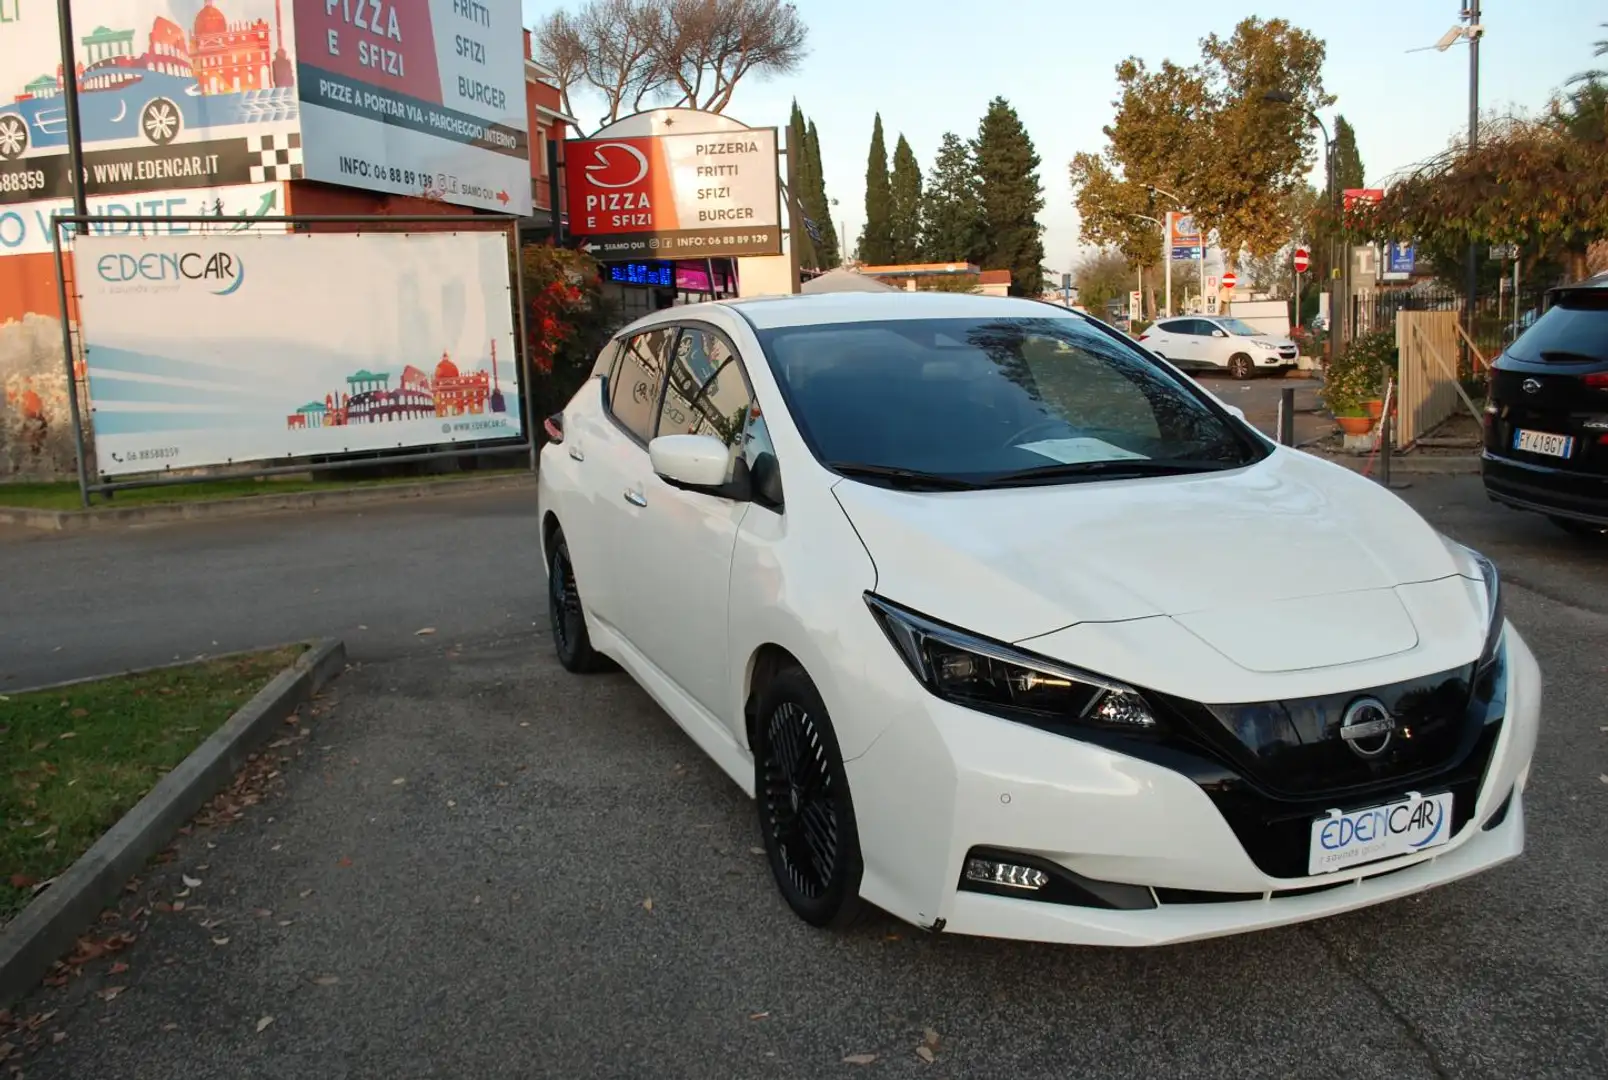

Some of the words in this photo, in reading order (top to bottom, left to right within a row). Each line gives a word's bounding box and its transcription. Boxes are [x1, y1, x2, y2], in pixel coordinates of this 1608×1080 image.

[328, 28, 339, 56] E
[359, 40, 404, 77] SFIZI
[455, 34, 486, 66] SFIZI
[458, 76, 506, 111] BURGER
[319, 79, 353, 104] PIZZE
[354, 89, 363, 107] A
[364, 92, 406, 119] PORTAR
[406, 104, 424, 124] VIA
[428, 111, 483, 140] PARCHEGGIO
[484, 128, 517, 149] INTERNO
[696, 141, 759, 156] PIZZERIA
[93, 154, 219, 184] WWW.EDENCAR.IT
[339, 156, 373, 178] INFO:
[374, 165, 387, 180] 06
[389, 167, 402, 183] 88
[404, 170, 416, 185] 89
[418, 173, 433, 188] 139
[696, 164, 739, 178] FRITTI
[0, 169, 45, 193] 88359
[461, 183, 482, 198] SIAMO
[586, 191, 651, 212] PIZZA
[697, 186, 731, 200] SFIZI
[587, 216, 597, 228] E
[612, 213, 653, 227] SFIZI
[698, 207, 754, 222] BURGER
[604, 242, 630, 251] SIAMO
[630, 241, 646, 250] QUI
[677, 236, 707, 247] INFO:
[708, 236, 721, 246] 06
[723, 235, 735, 245] 88
[737, 235, 749, 245] 89
[751, 233, 769, 244] 139
[97, 251, 236, 282] EDENCAR
[1320, 799, 1434, 850] EDENCAR
